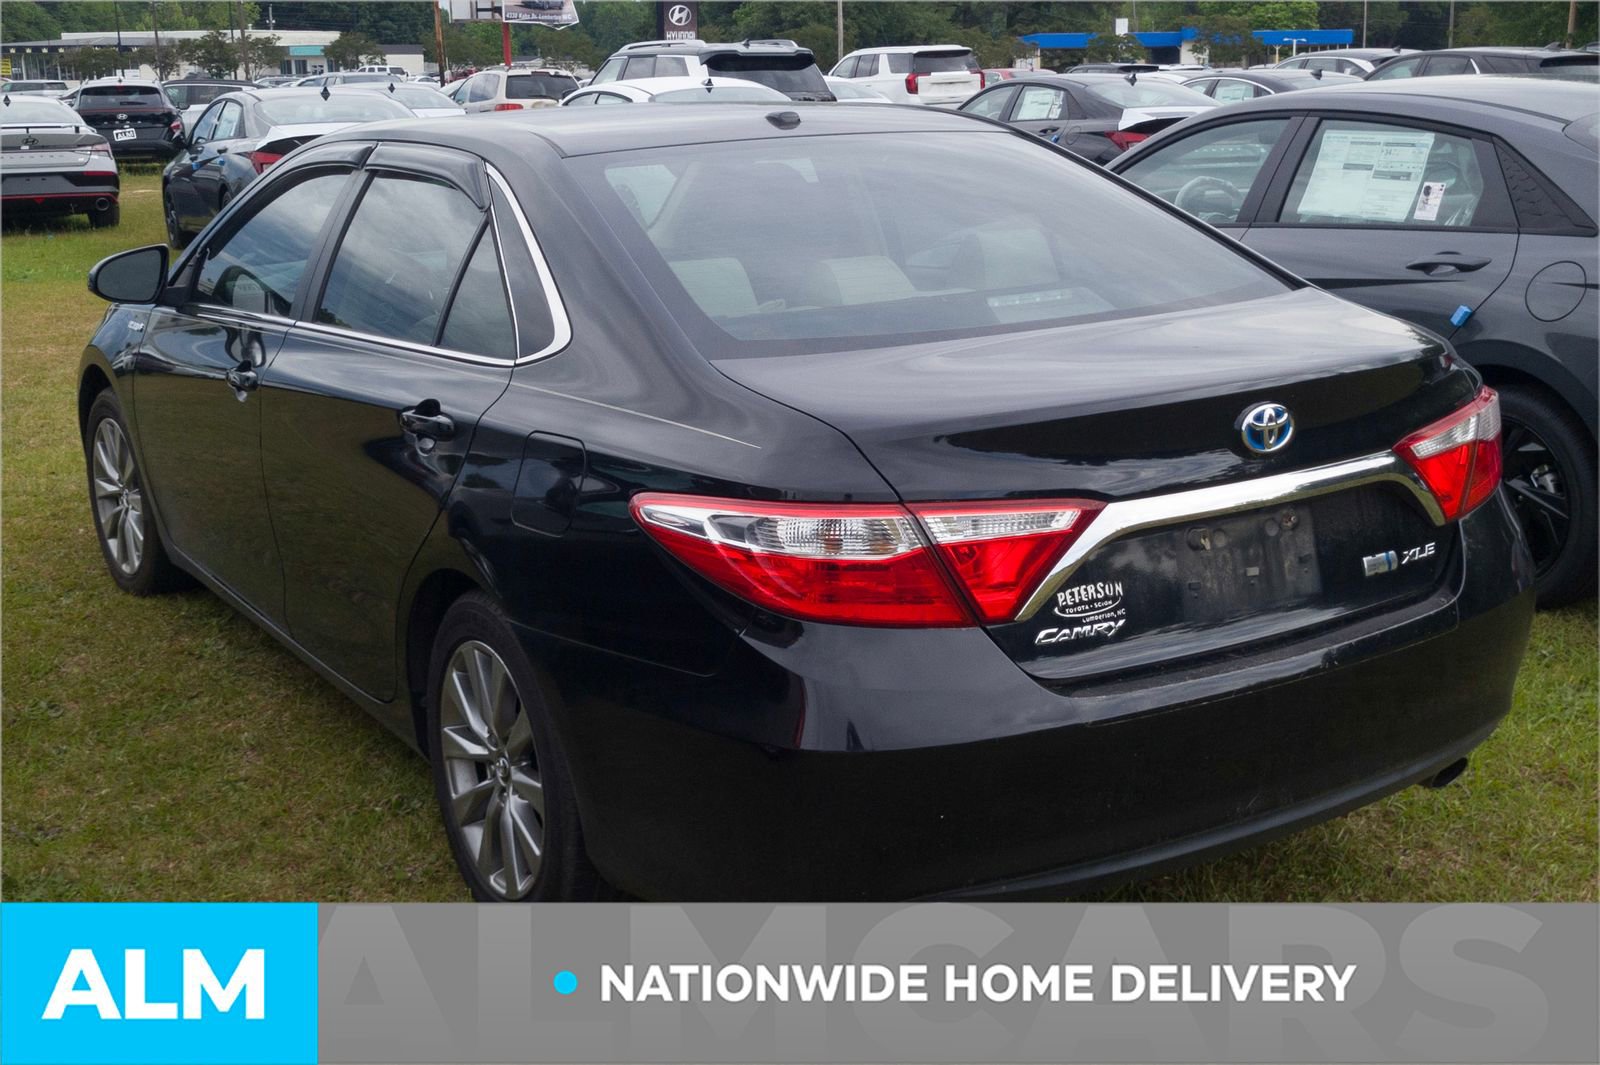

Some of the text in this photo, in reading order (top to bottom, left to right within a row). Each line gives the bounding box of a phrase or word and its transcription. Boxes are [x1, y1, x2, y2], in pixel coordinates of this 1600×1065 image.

[666, 31, 696, 41] HYUNDAI
[117, 131, 135, 140] ALM
[1401, 542, 1436, 565] XLE
[1057, 581, 1123, 607] PETERSON
[1065, 604, 1090, 614] TOYOTA
[1116, 608, 1127, 617] NC
[1034, 618, 1127, 645] CAMRY
